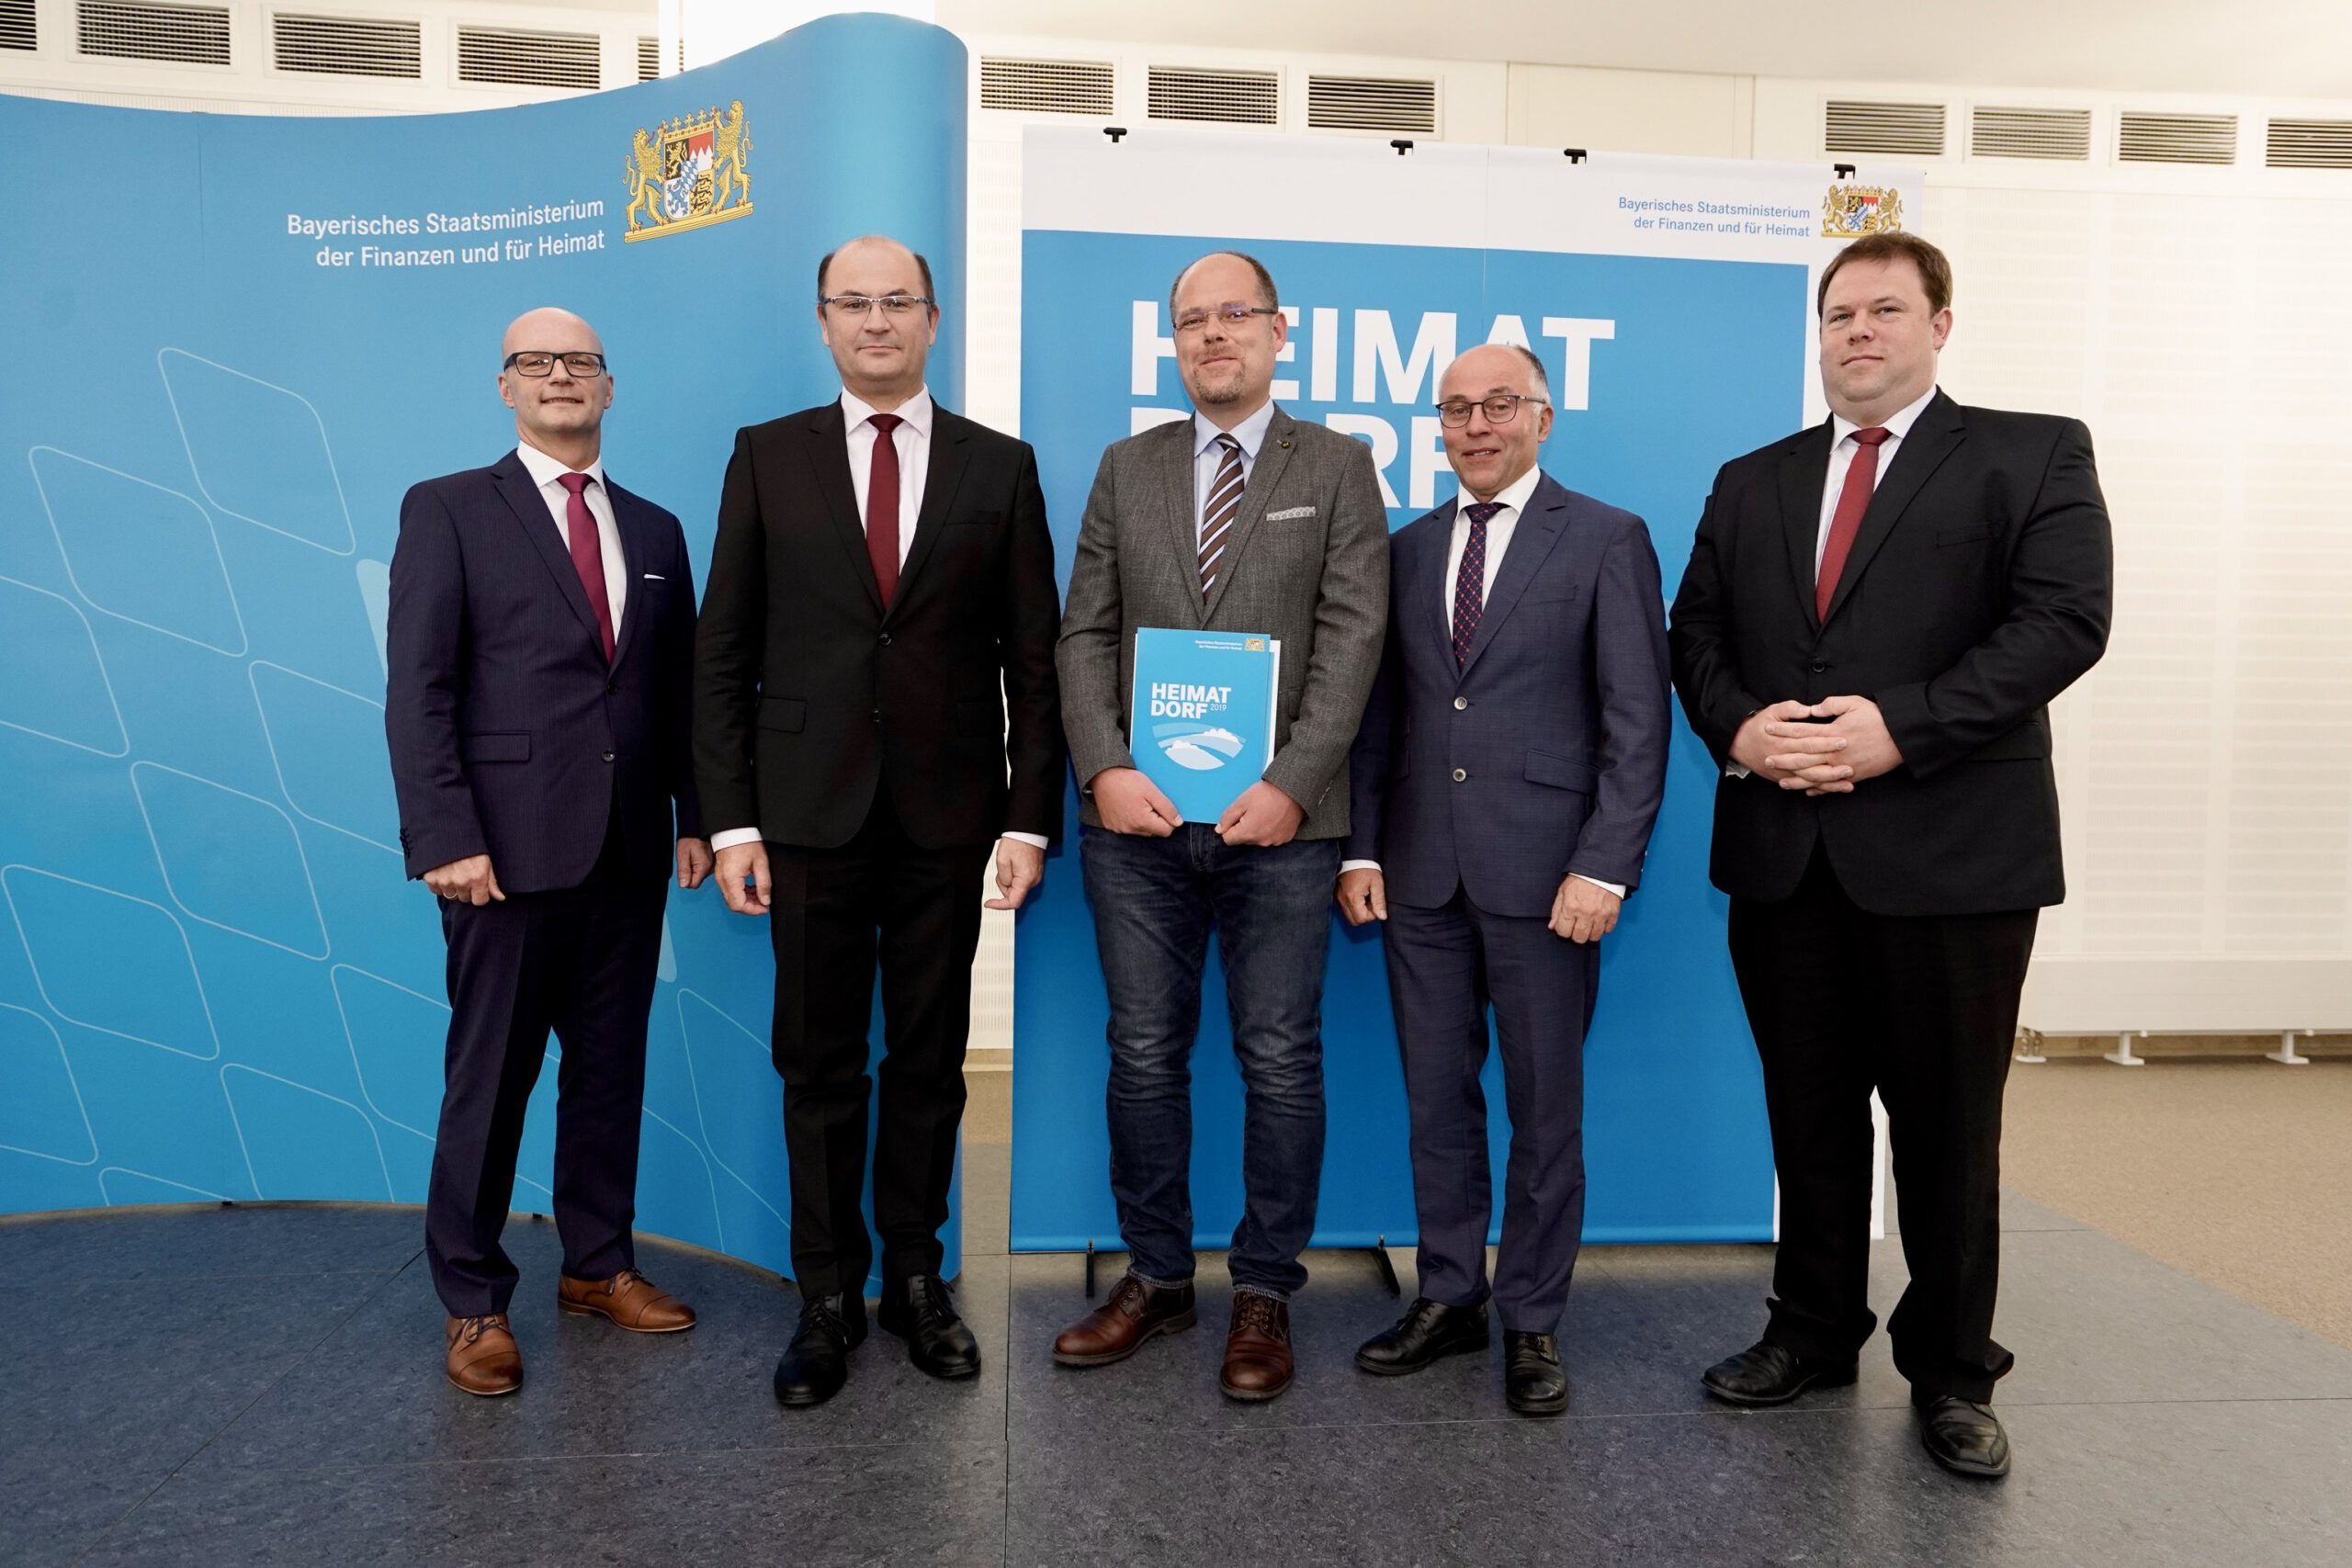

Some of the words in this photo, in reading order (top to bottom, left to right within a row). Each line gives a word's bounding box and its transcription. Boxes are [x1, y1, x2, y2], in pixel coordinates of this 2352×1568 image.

[1618, 197, 1693, 213] Bayerisches
[1697, 200, 1810, 219] Staatsministerium
[287, 213, 420, 241] Bayerisches
[425, 198, 604, 234] Staatsministerium
[1634, 216, 1655, 229] der
[1658, 217, 1713, 231] Finanzen
[1717, 221, 1741, 233] und
[1744, 221, 1762, 234] für
[1766, 223, 1809, 237] Heimat
[315, 245, 355, 267] der
[361, 245, 455, 267] Finanzen
[461, 241, 500, 265] und
[504, 239, 533, 261] für
[538, 229, 605, 257] Heimat
[1151, 682, 1232, 705] HEIMAT
[1150, 700, 1209, 719] DORF
[1210, 703, 1227, 712] 2019
